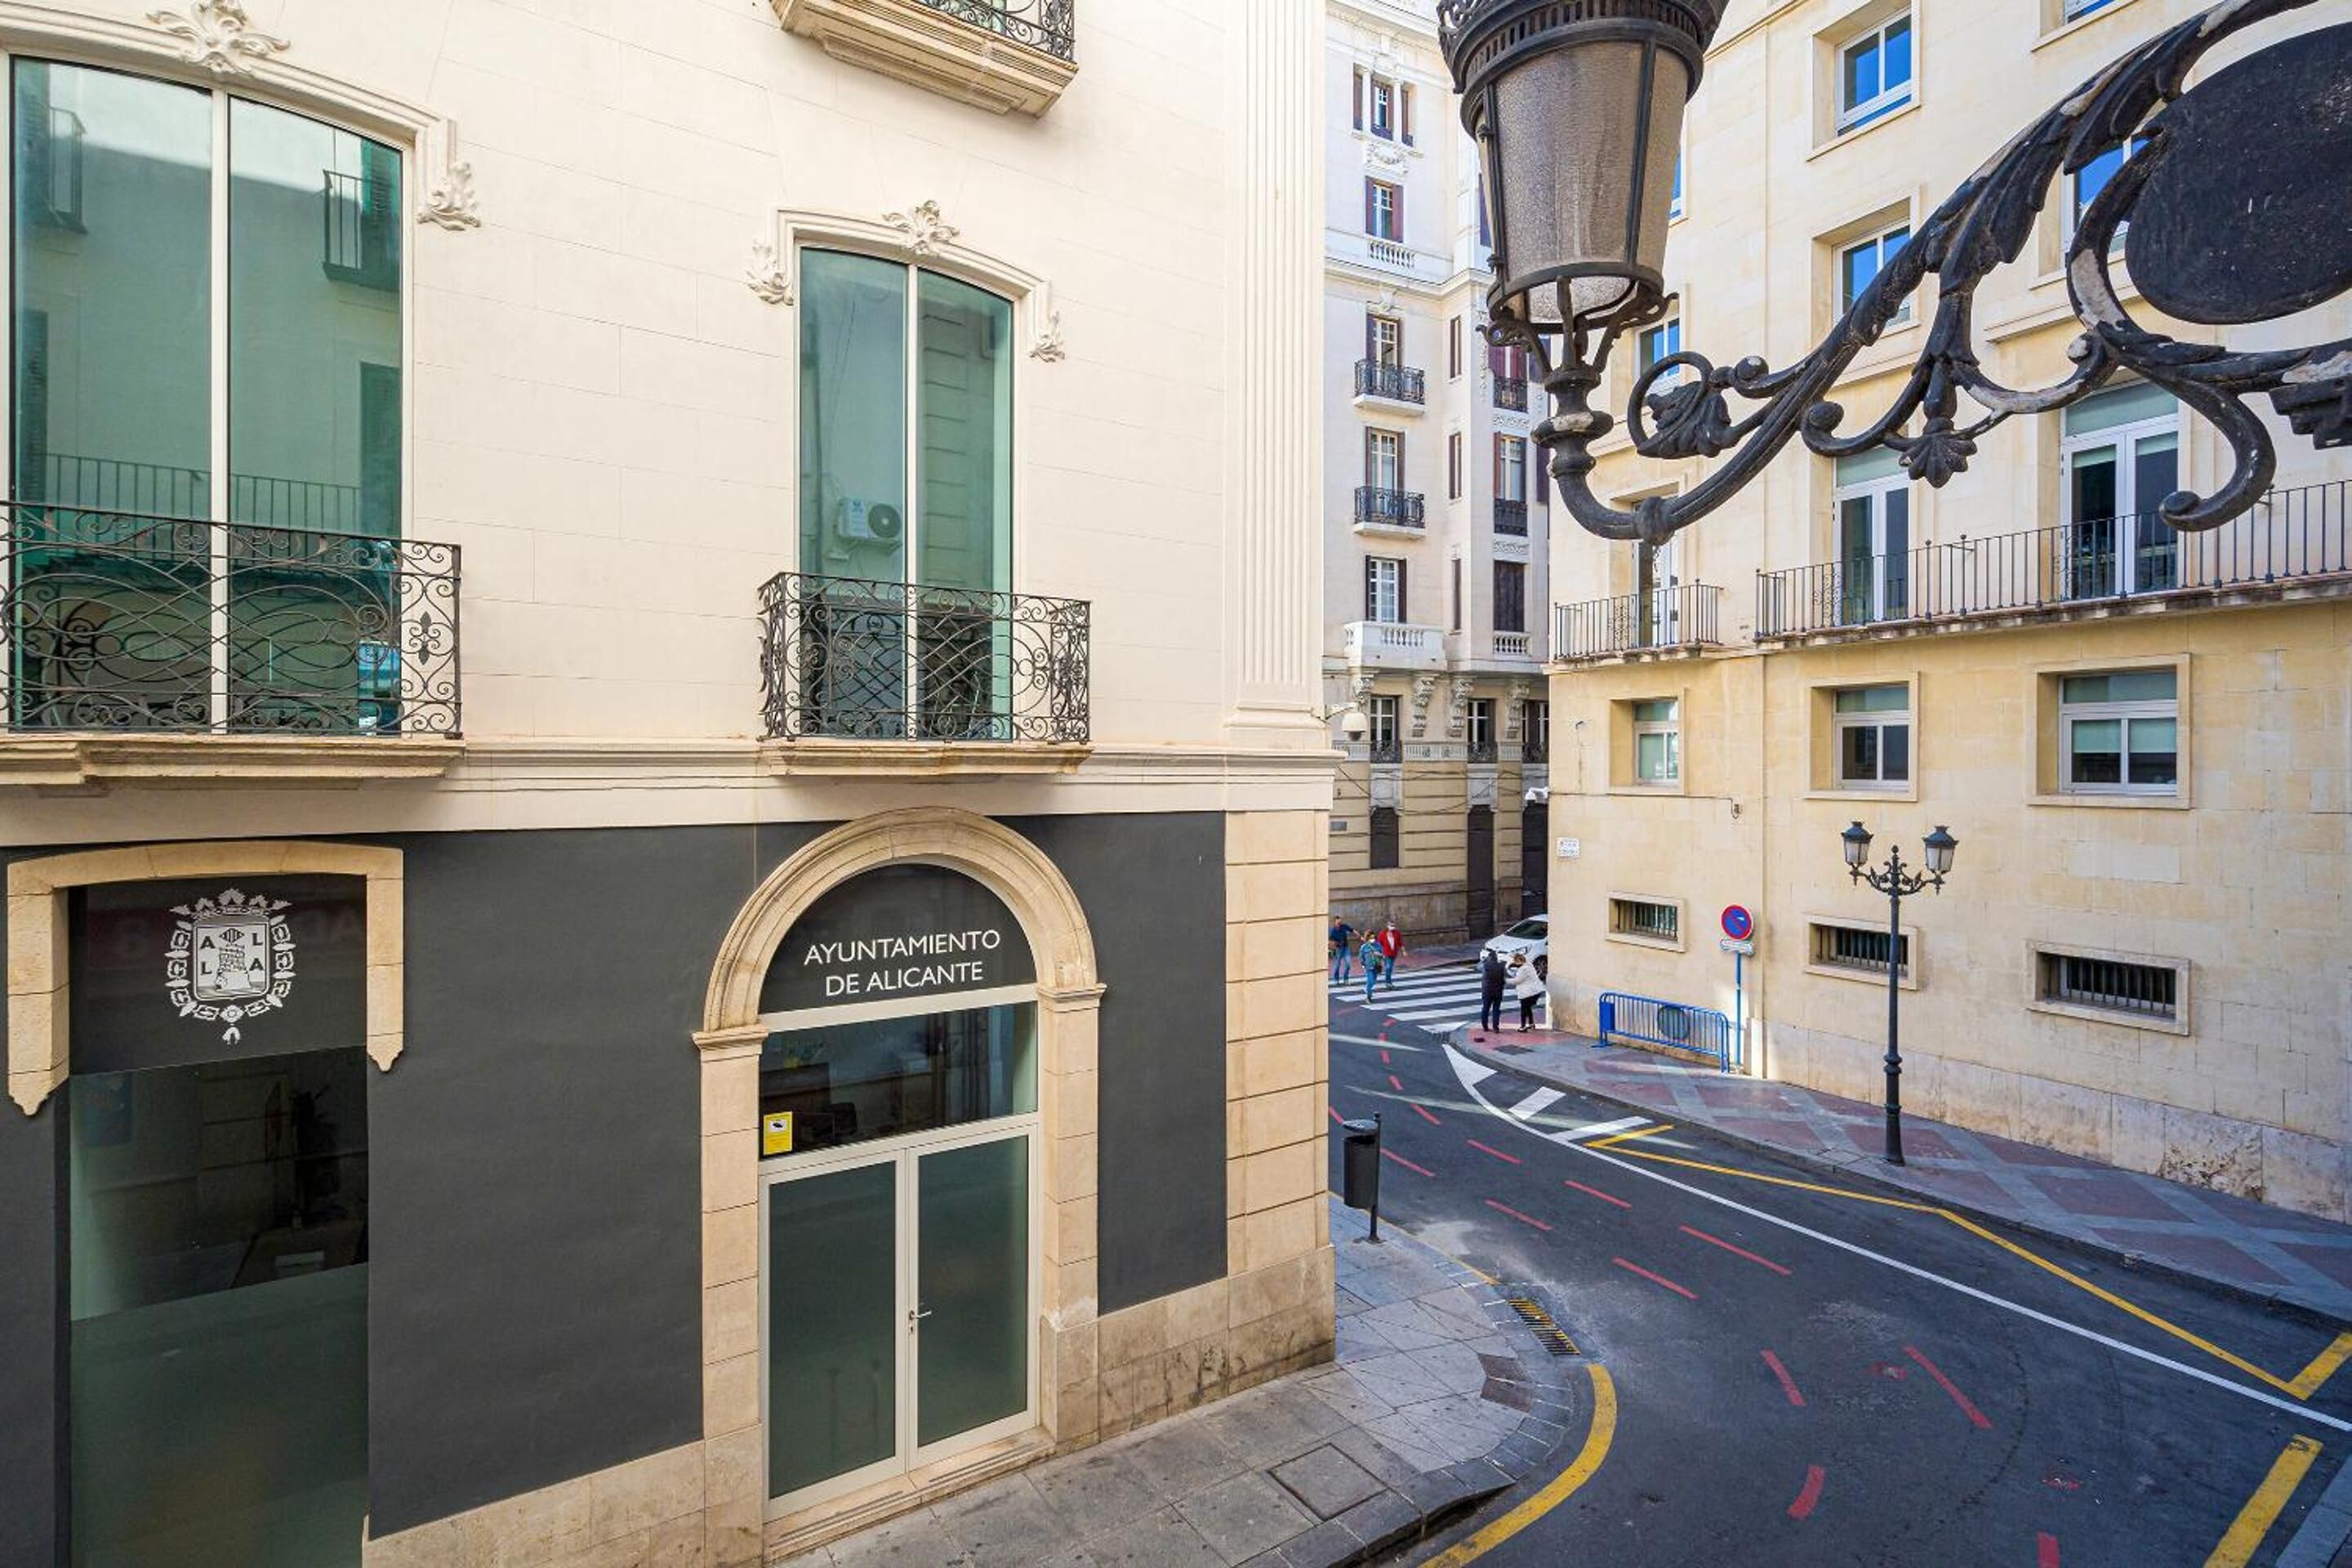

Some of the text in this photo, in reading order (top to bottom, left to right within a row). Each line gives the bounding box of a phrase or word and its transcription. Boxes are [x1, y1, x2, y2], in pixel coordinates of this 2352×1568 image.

[200, 933, 264, 950] A L
[804, 929, 1001, 966] AYUNTAMIENTO
[201, 958, 264, 975] L A
[826, 961, 984, 997] DE ALICANTE
